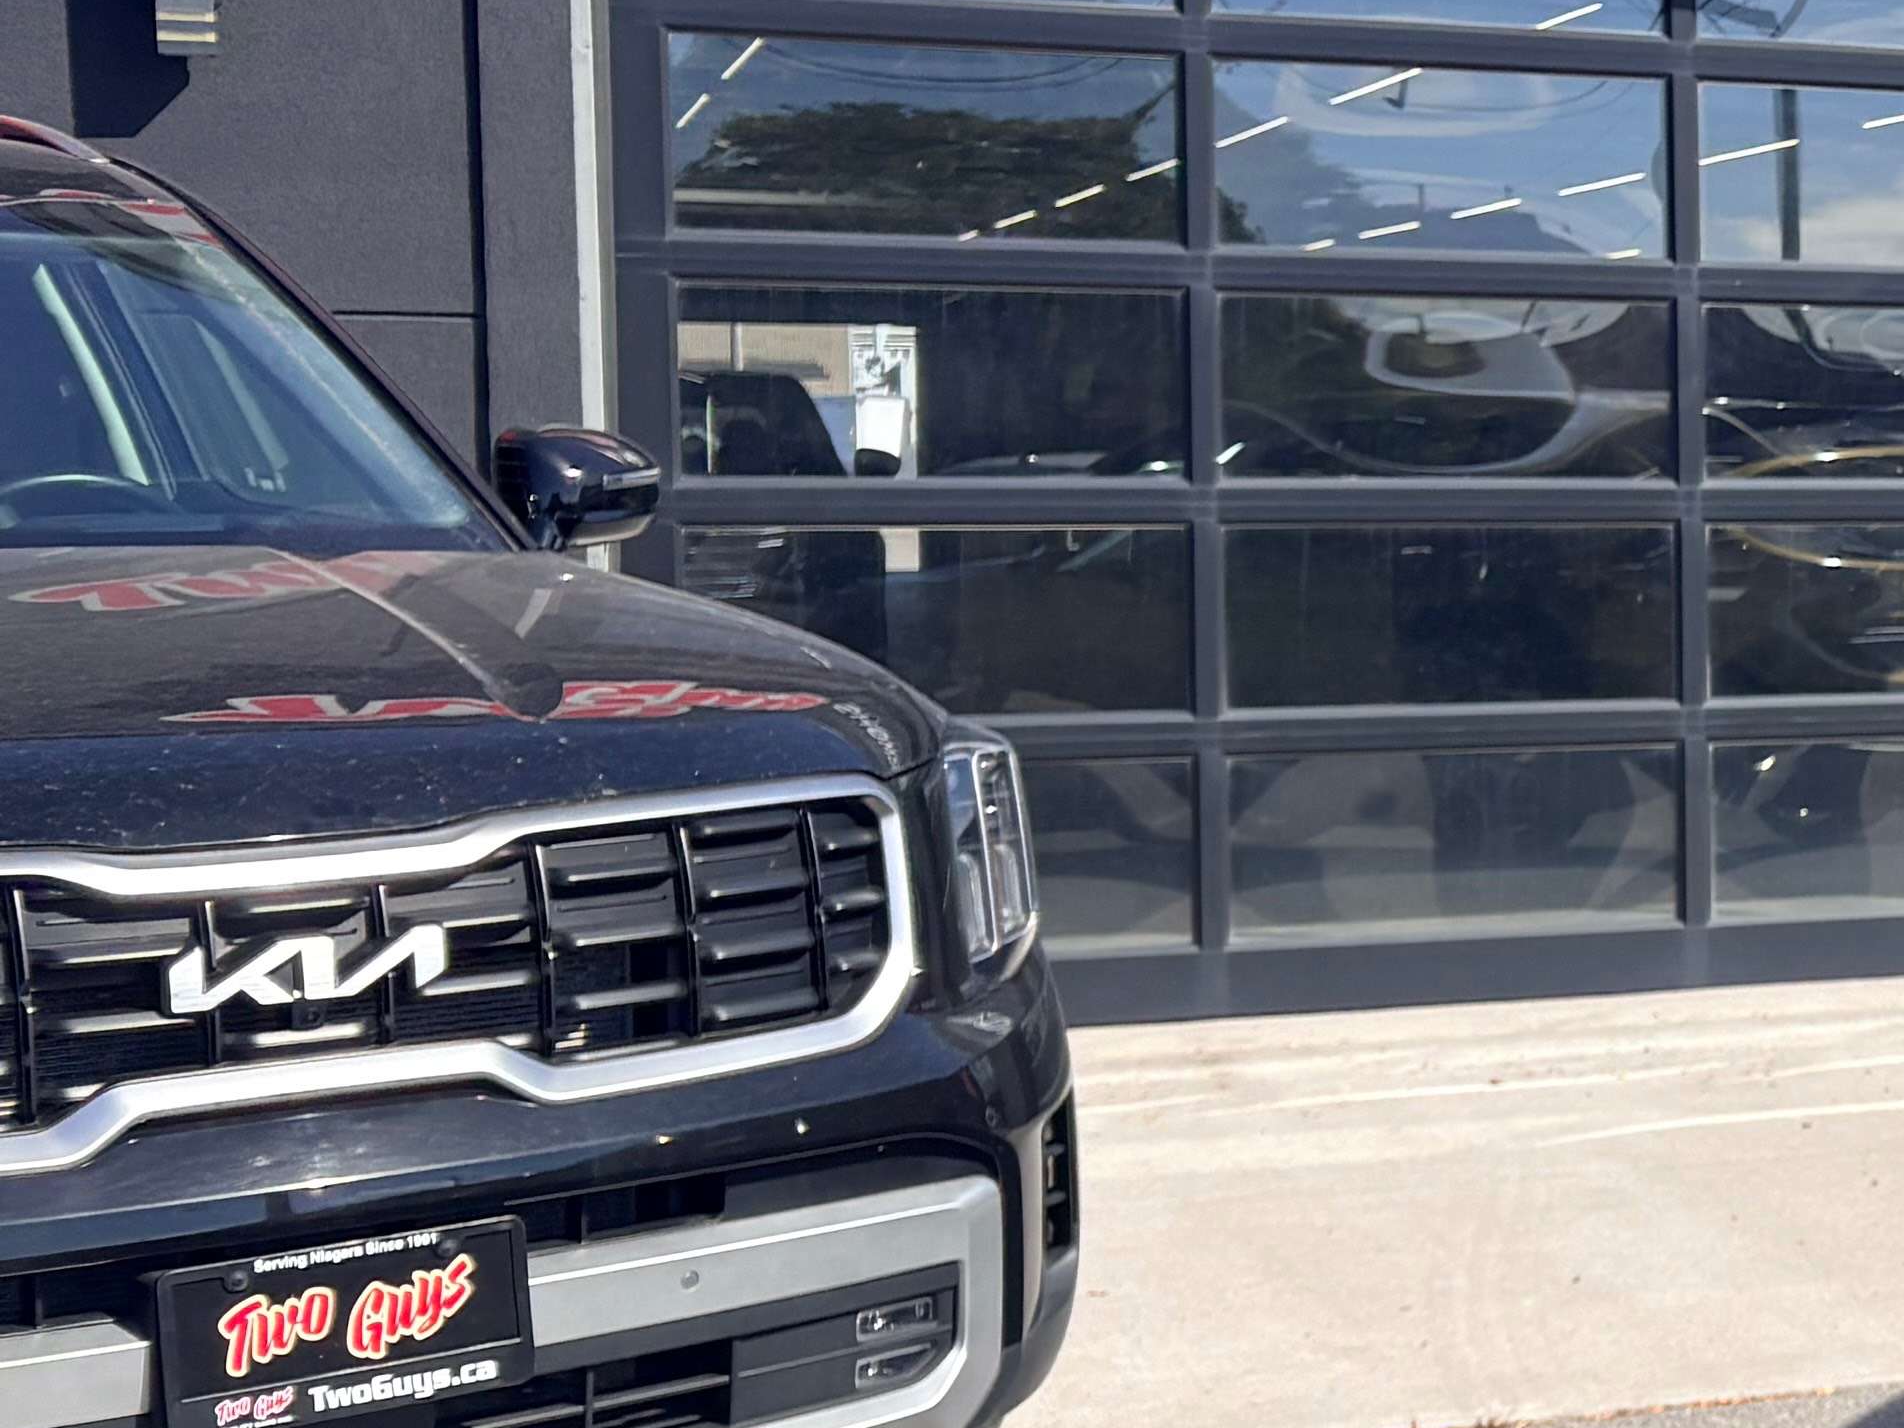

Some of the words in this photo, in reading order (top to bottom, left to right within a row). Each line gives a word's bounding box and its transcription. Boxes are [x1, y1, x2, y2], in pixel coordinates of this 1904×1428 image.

[253, 1254, 308, 1274] Serving
[310, 1245, 364, 1265] Niagara
[365, 1238, 404, 1256] Since
[218, 1286, 336, 1377] Two
[347, 1253, 476, 1359] Guys
[308, 1359, 498, 1413] TwoGuys.ca
